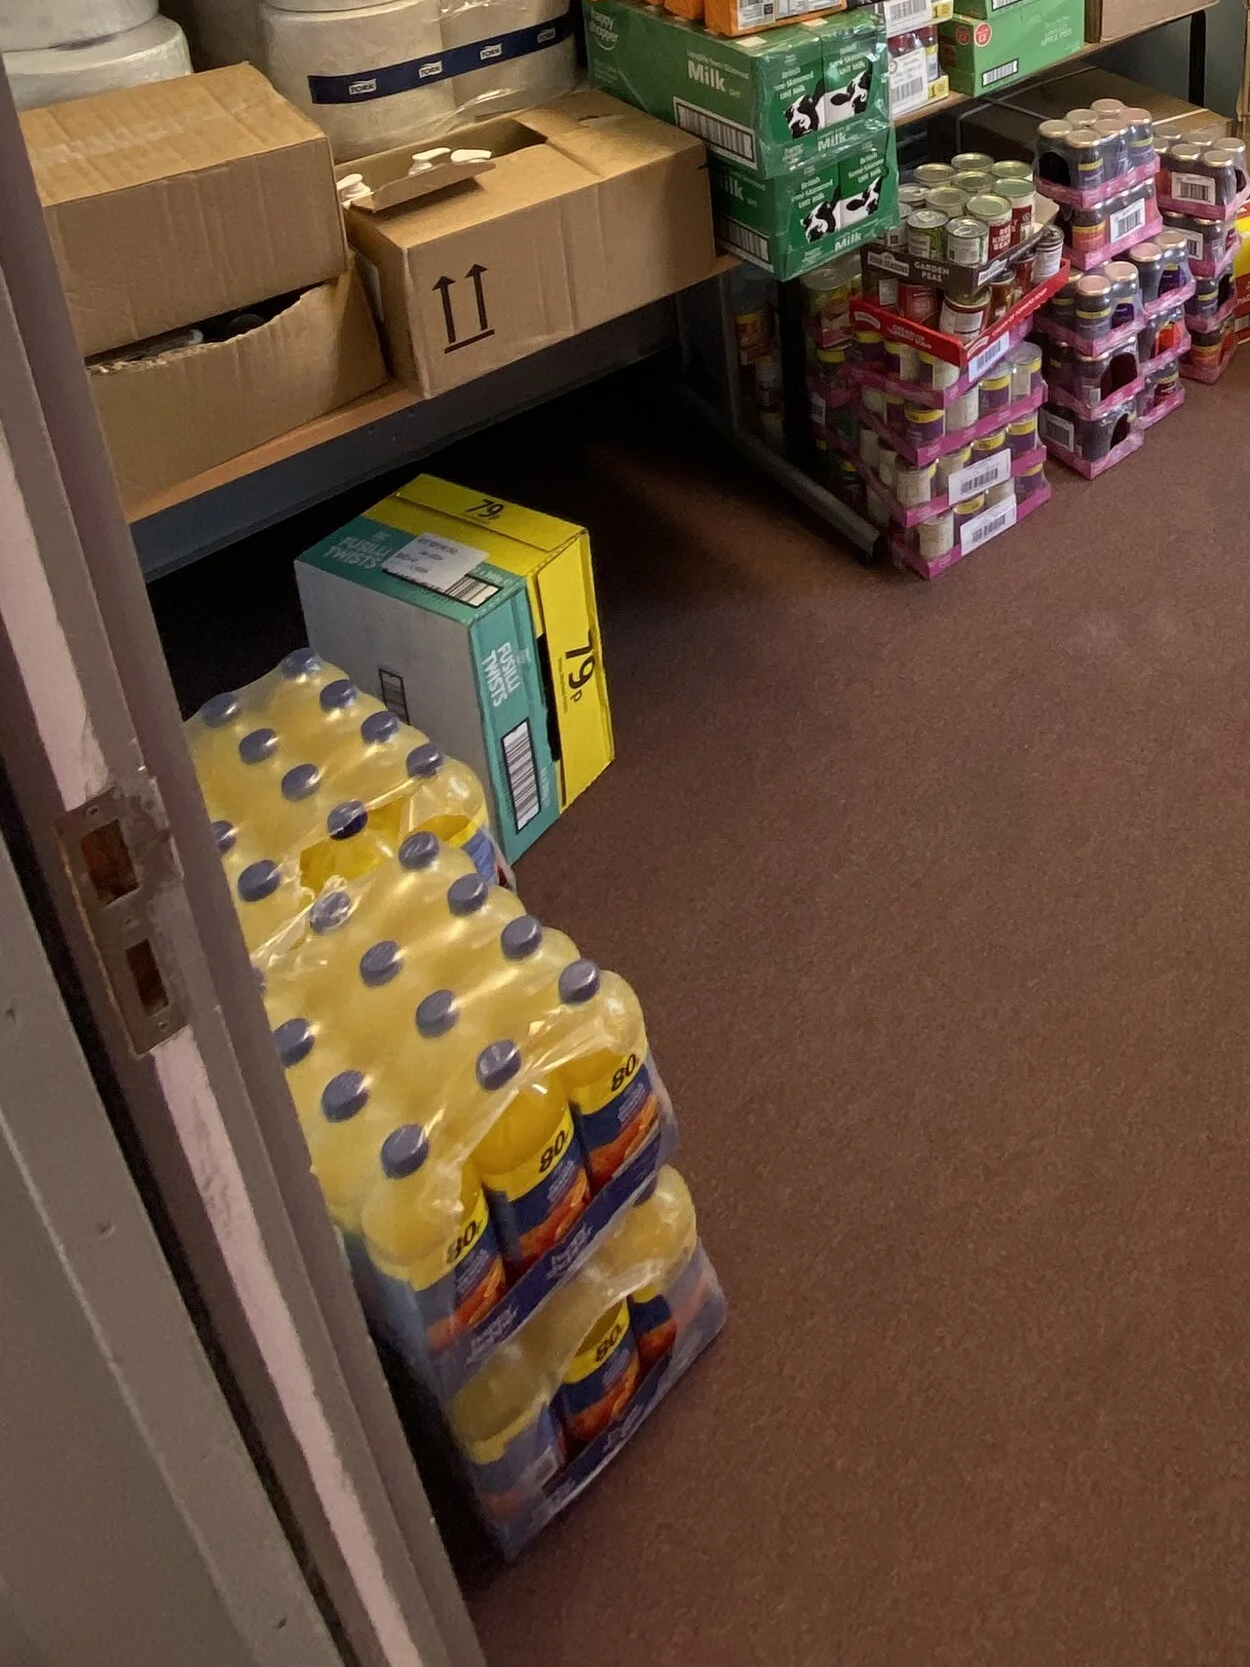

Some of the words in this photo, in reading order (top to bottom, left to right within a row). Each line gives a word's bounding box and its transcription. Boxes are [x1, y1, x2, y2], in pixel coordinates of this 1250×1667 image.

[480, 47, 501, 59] TORK
[420, 66, 442, 78] TORK
[687, 59, 727, 93] Milk
[350, 82, 376, 93] TORK
[817, 131, 847, 152] Milk
[723, 174, 746, 201] ilk
[834, 231, 862, 252] Milk
[914, 261, 949, 276] GARDEN
[921, 271, 943, 282] PEAS
[341, 536, 394, 557] FUSILLI
[325, 545, 384, 570] TWISTS
[481, 648, 509, 709] TWISTS
[497, 641, 521, 695] FUSILLI
